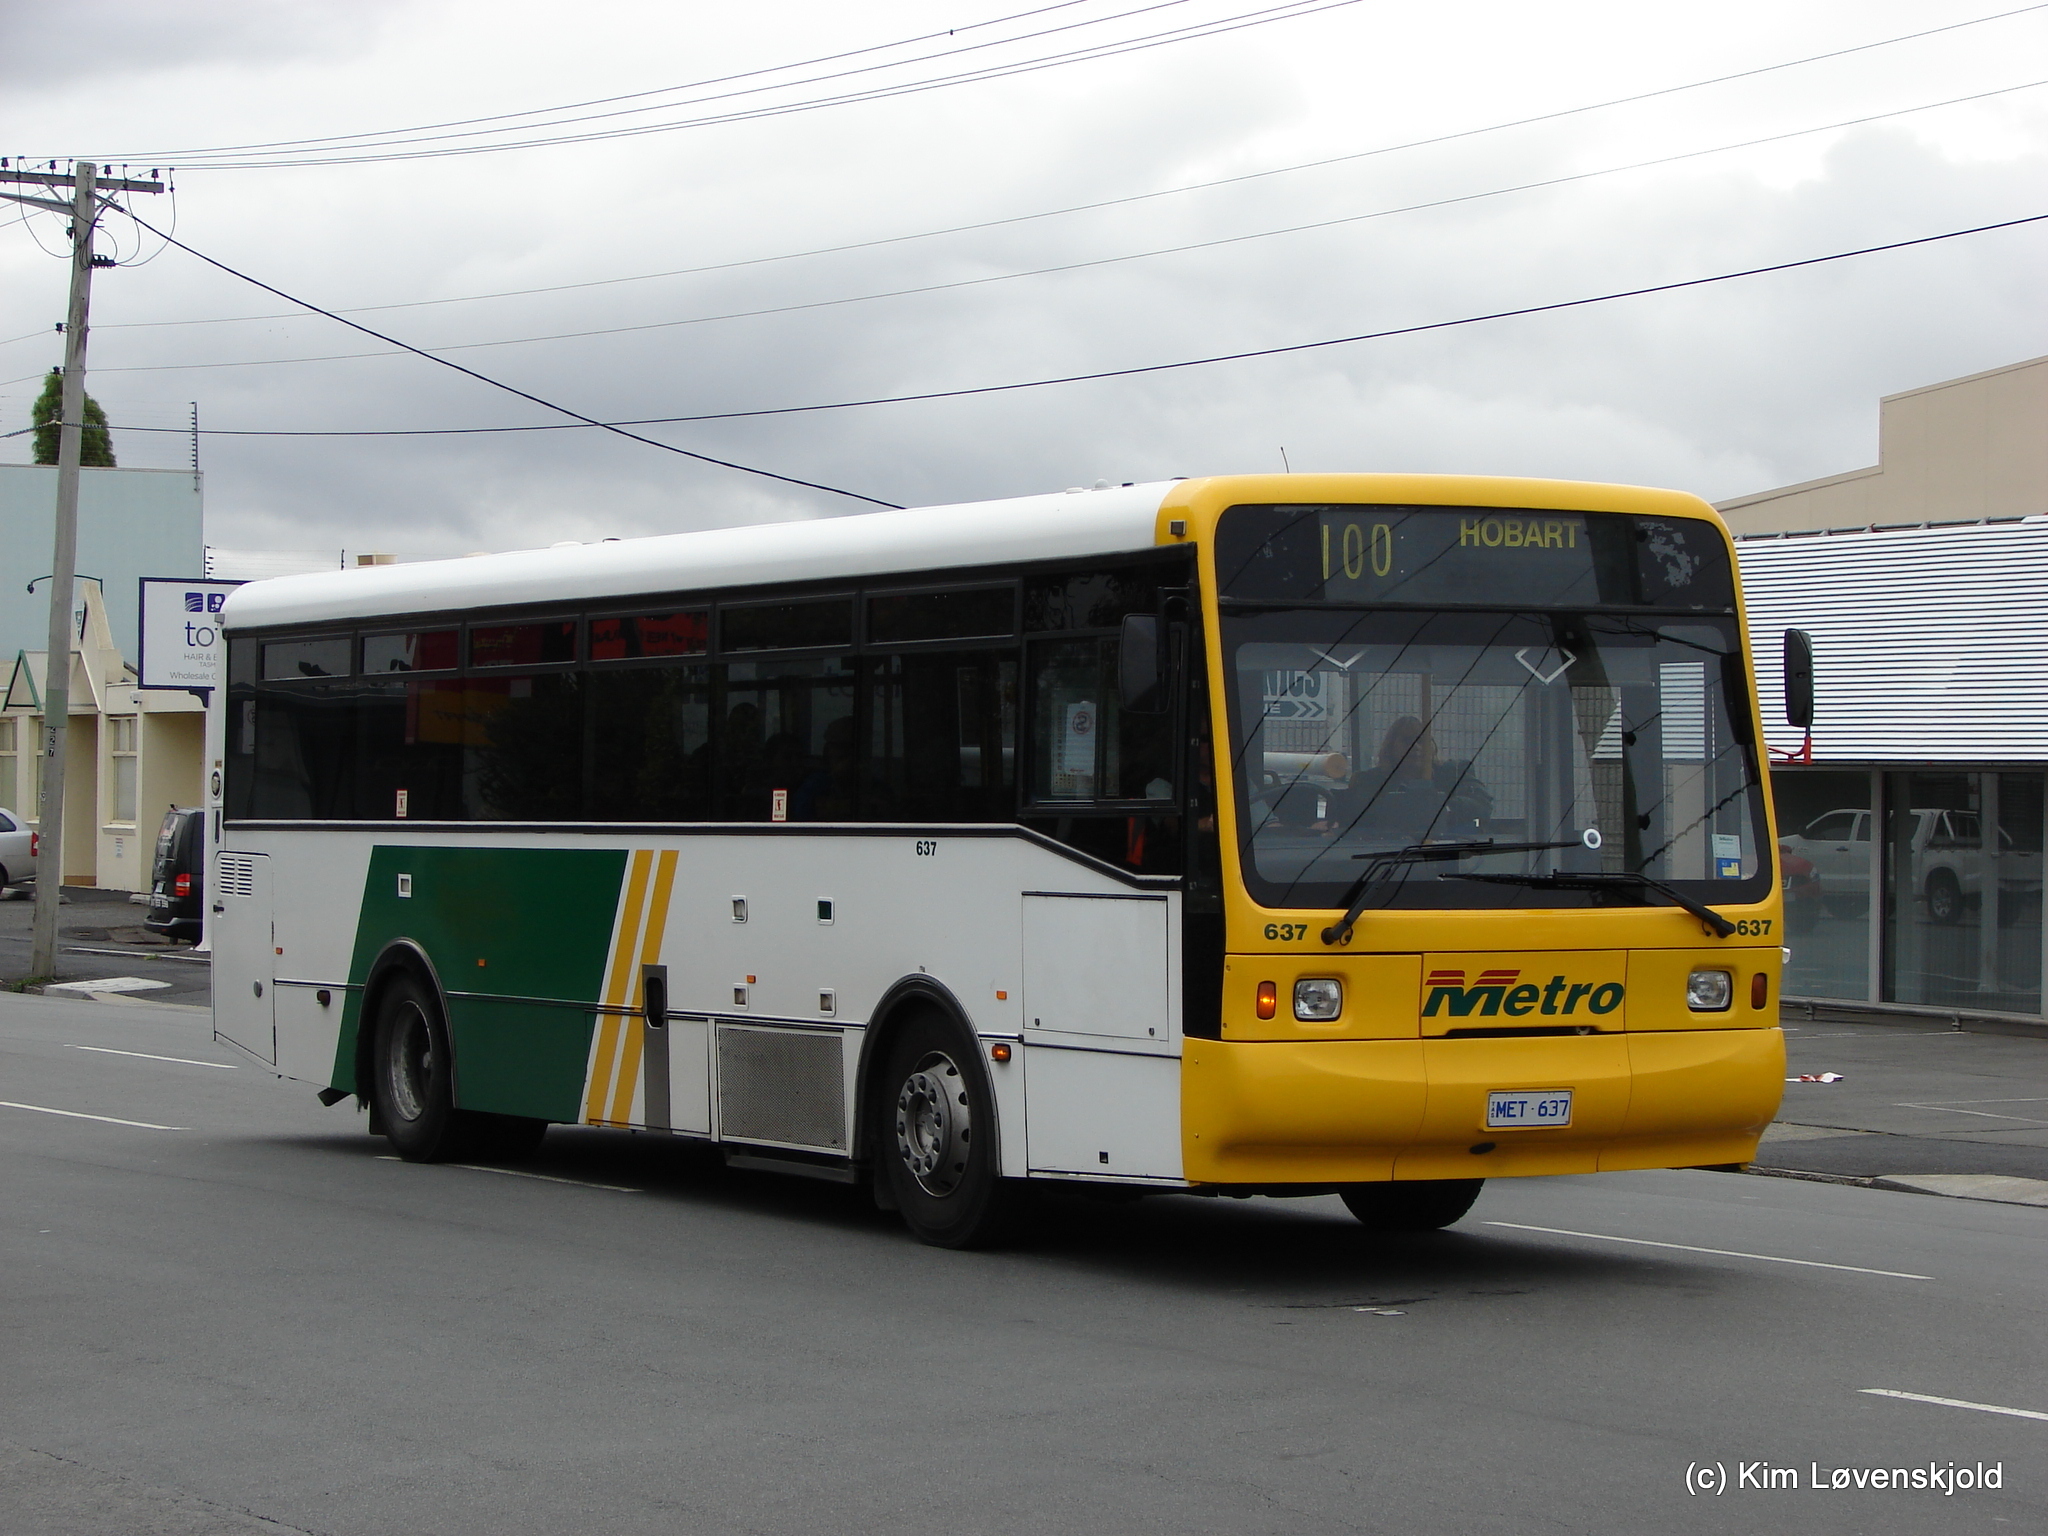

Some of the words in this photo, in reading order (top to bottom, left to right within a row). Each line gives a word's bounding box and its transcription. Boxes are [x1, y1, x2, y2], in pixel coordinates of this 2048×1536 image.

[1322, 524, 1391, 580] 100
[1460, 518, 1581, 548] HOBART
[184, 653, 204, 661] HAIR
[169, 672, 209, 680] Wholesale
[916, 840, 937, 856] 637
[1264, 923, 1308, 941] 637
[1737, 919, 1772, 936] 637
[1421, 969, 1625, 1017] Metro
